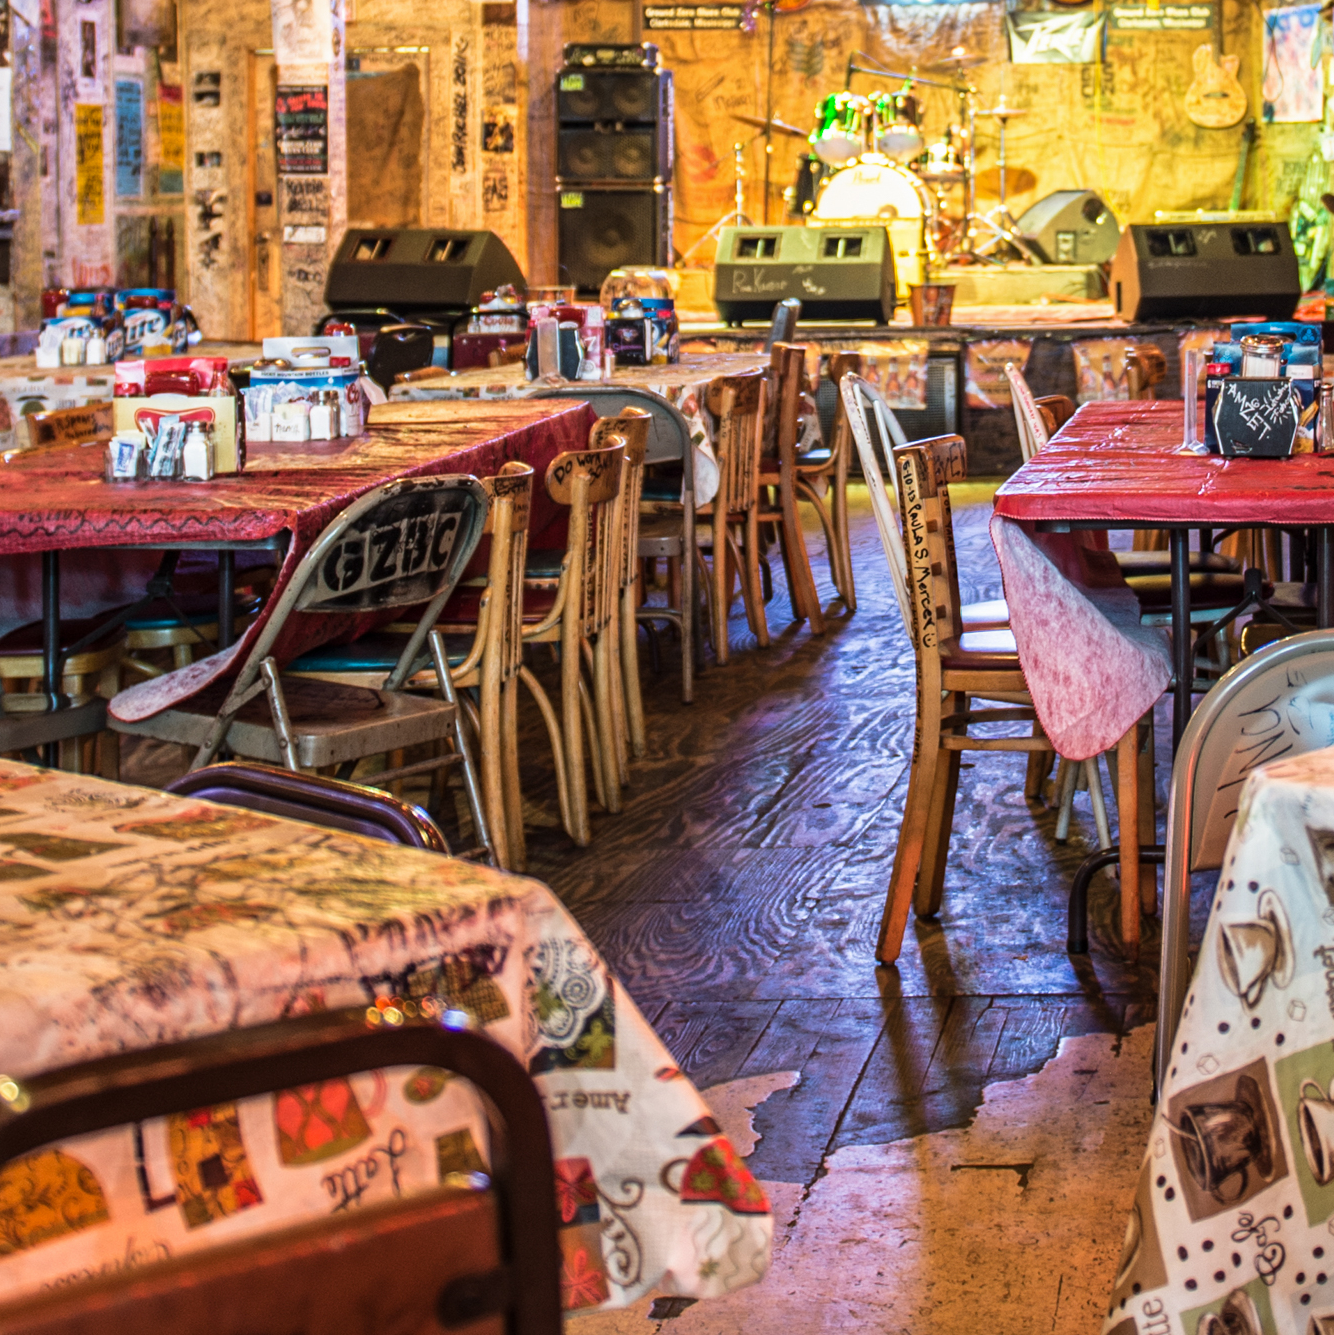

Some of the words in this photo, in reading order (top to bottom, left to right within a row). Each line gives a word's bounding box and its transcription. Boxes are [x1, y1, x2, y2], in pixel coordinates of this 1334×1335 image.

[553, 459, 574, 486] DO
[903, 504, 925, 546] PAULA
[912, 566, 936, 631] Mercer
[321, 1128, 407, 1214] Latte
